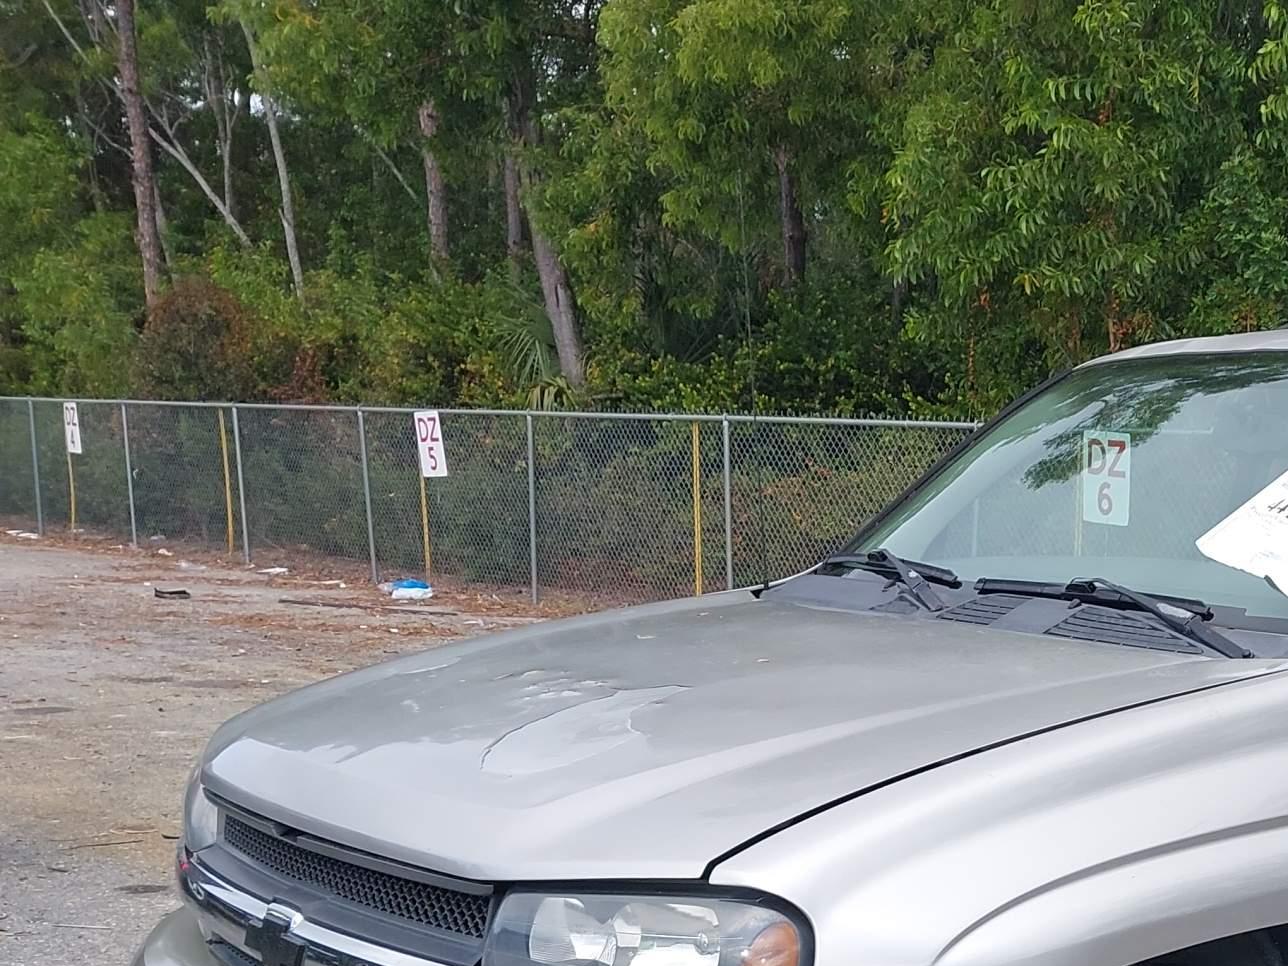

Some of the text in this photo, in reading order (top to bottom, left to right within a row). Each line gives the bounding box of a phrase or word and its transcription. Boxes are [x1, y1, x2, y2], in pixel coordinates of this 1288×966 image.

[65, 406, 77, 427] DZ
[417, 416, 439, 442] DZ
[427, 446, 438, 471] 5
[1087, 438, 1127, 479] DZ
[1097, 481, 1113, 516] 6
